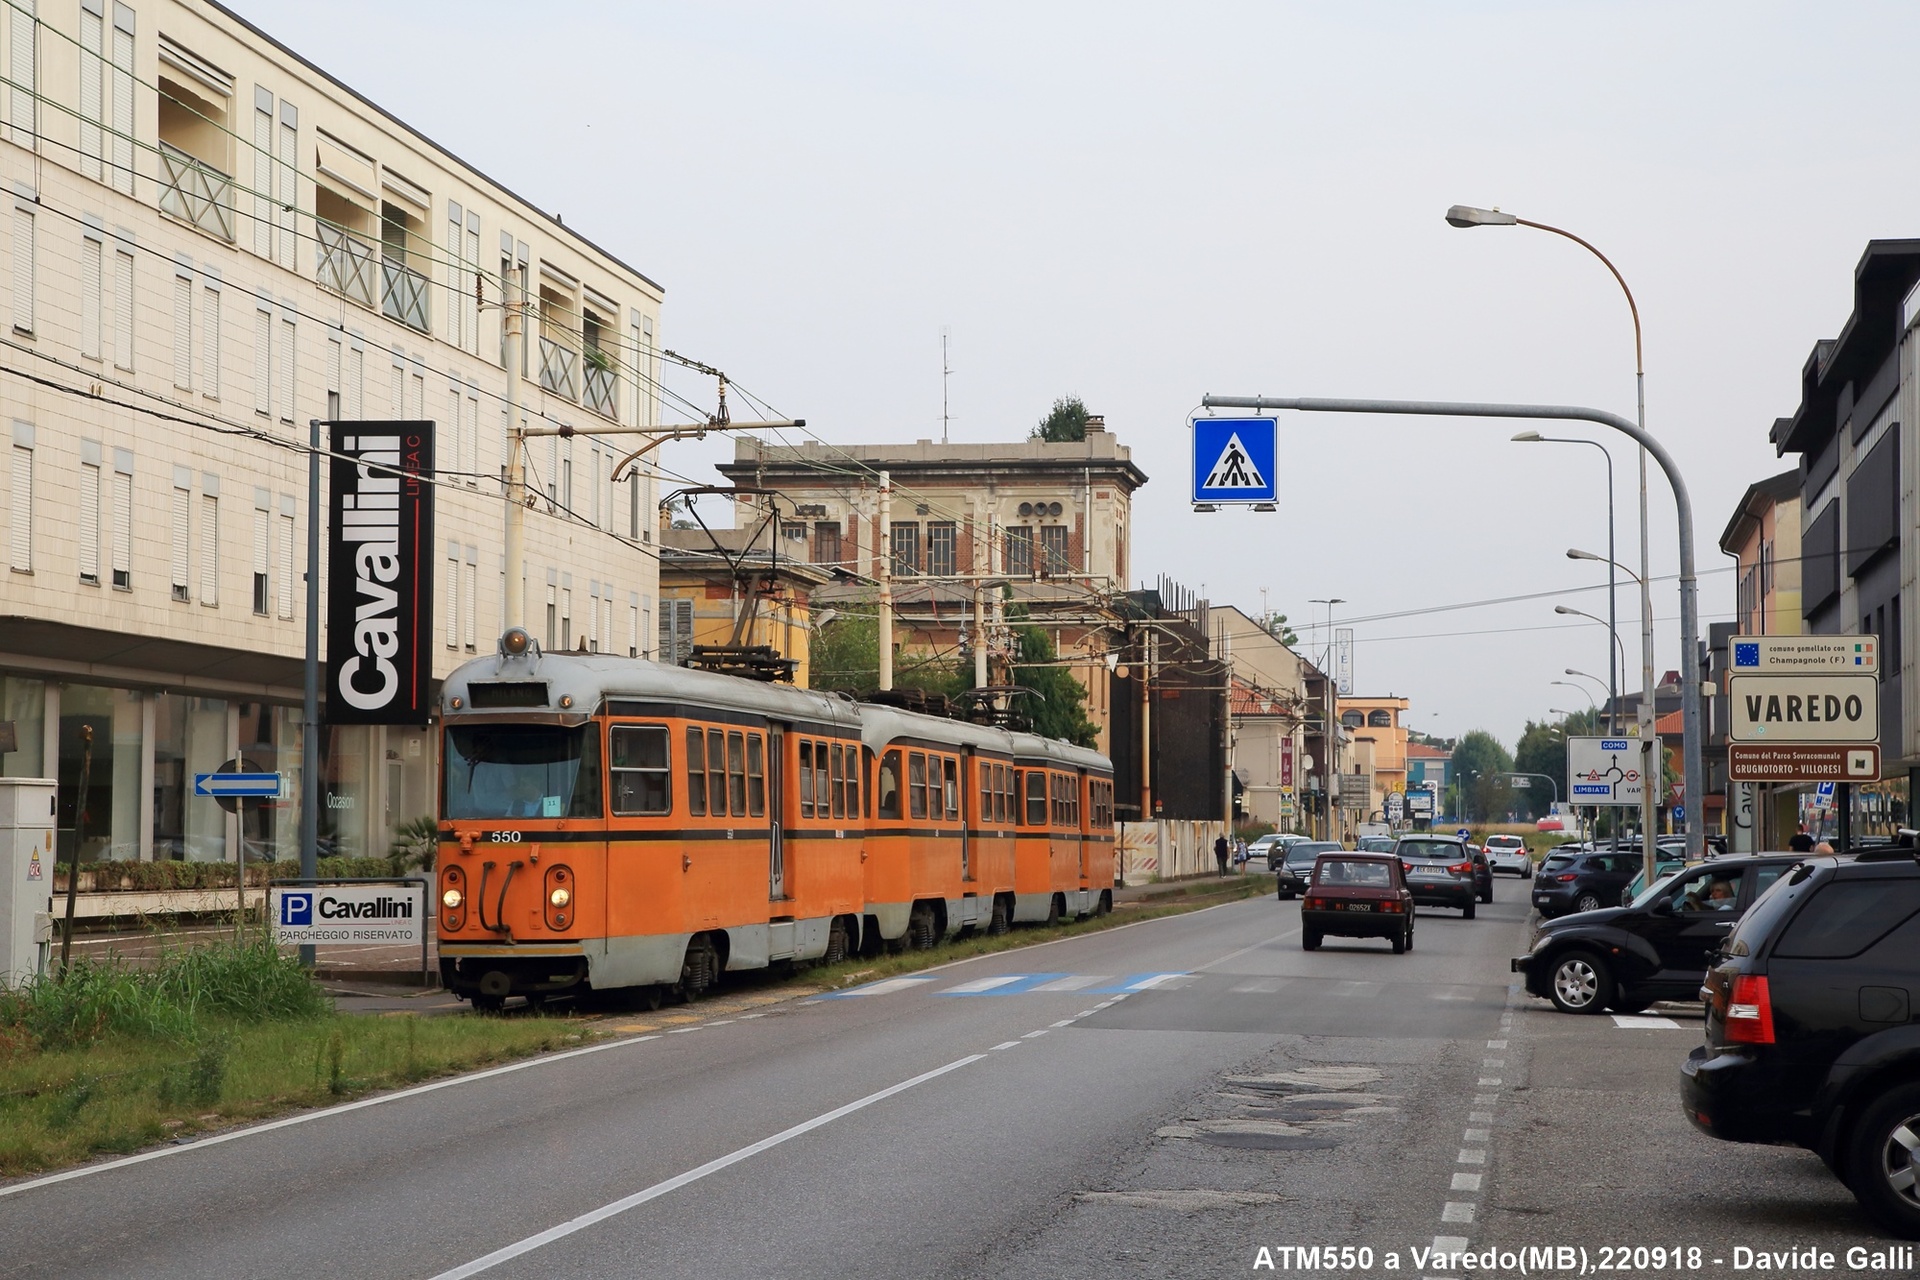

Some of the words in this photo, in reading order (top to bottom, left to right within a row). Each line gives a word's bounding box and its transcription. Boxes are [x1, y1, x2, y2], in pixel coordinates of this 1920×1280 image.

[406, 435, 420, 447] C
[407, 451, 420, 495] LINEA
[338, 435, 400, 710] Cavallini
[1797, 644, 1831, 653] gemellato
[1769, 656, 1826, 664] Champagnole
[1829, 656, 1846, 664] (F)
[1745, 694, 1863, 722] VAREDO
[1735, 751, 1759, 760] Comune
[1761, 751, 1771, 760] del
[1773, 751, 1791, 760] Parco
[1792, 751, 1841, 760] Sovracomunale
[1735, 764, 1793, 774] GRUGNOTORTO
[1800, 764, 1841, 774] VILLORESI
[327, 792, 355, 808] Occasioni
[491, 830, 521, 843] 550
[287, 896, 308, 923] P
[318, 896, 413, 919] Cavallini
[280, 930, 350, 940] PARCHEGGIO
[353, 930, 413, 940] RISERVATO
